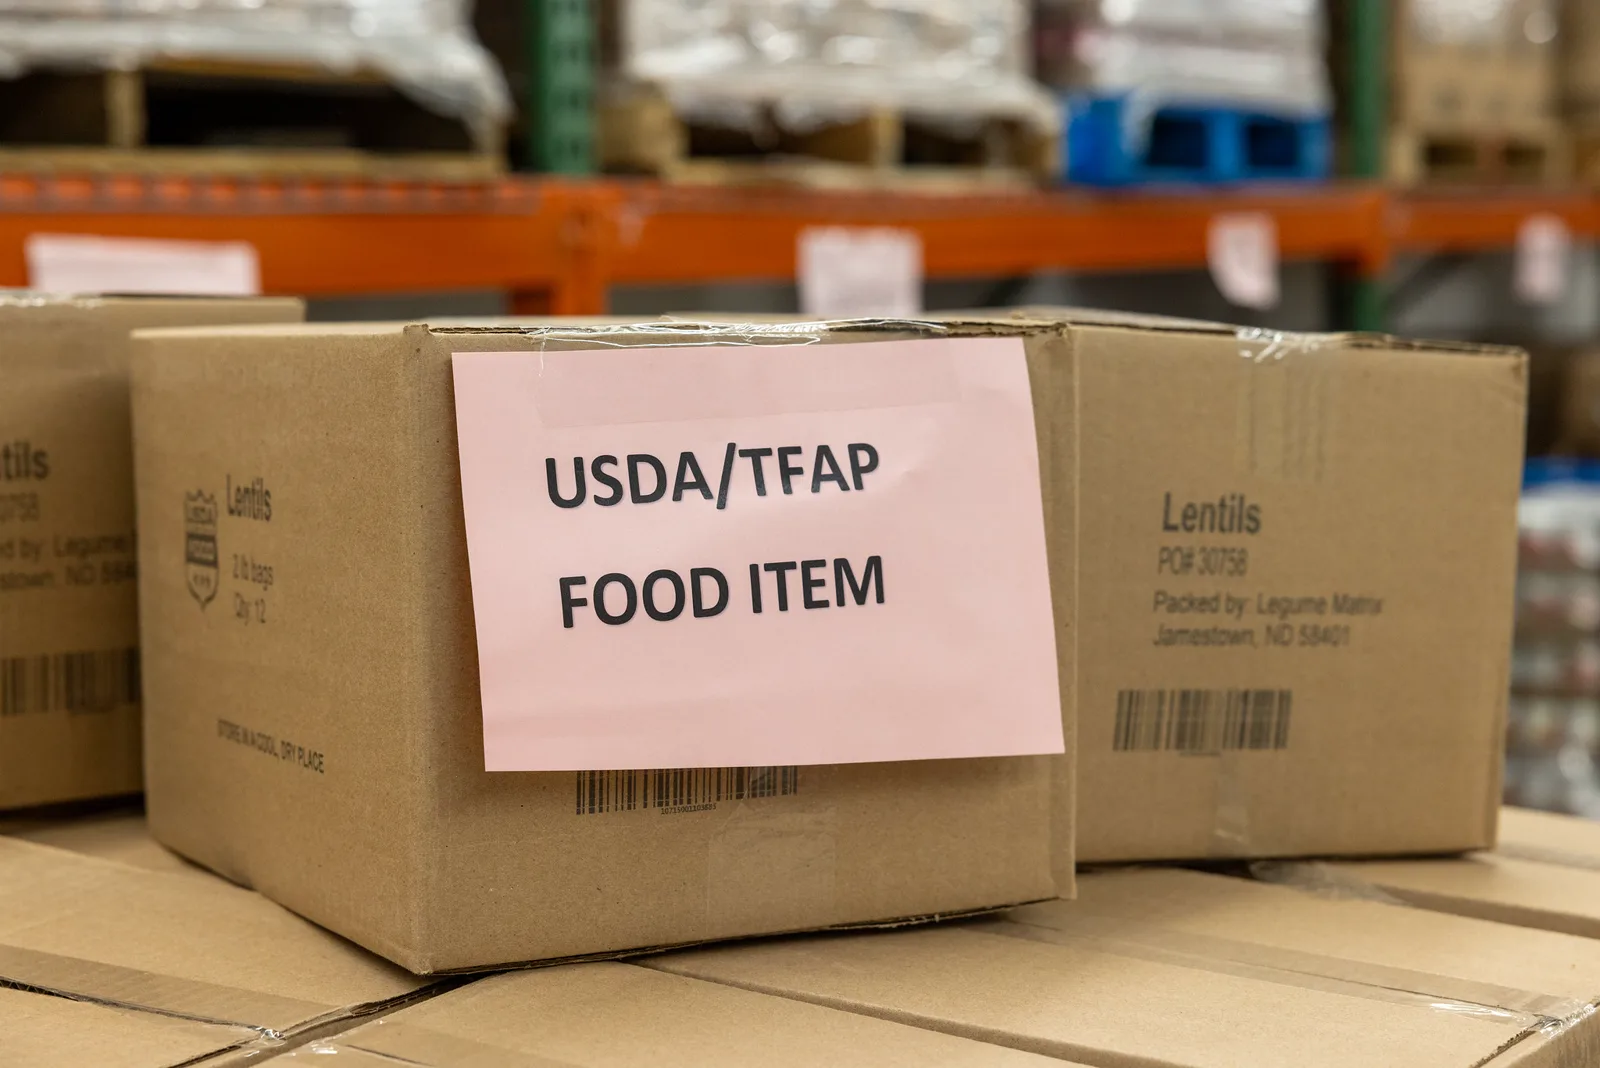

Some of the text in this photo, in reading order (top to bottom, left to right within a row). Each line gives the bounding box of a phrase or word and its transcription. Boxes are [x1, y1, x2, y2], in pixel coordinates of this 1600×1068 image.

[0, 441, 51, 483] tils
[545, 442, 881, 510] USDA/TFAP
[227, 474, 271, 522] Lentils
[1162, 492, 1263, 535] Lentils
[233, 553, 273, 591] 2 lb bags
[1158, 545, 1249, 577] PO# 30758
[559, 555, 885, 628] FOOD ITEM
[1153, 588, 1221, 614] Packed
[1256, 591, 1328, 621] Legume
[1331, 590, 1384, 616] Matrix
[254, 598, 266, 624] 12
[1264, 622, 1294, 647] ND
[1297, 623, 1351, 648] 58401
[280, 740, 295, 764] DRY
[297, 746, 324, 773] PLACE
